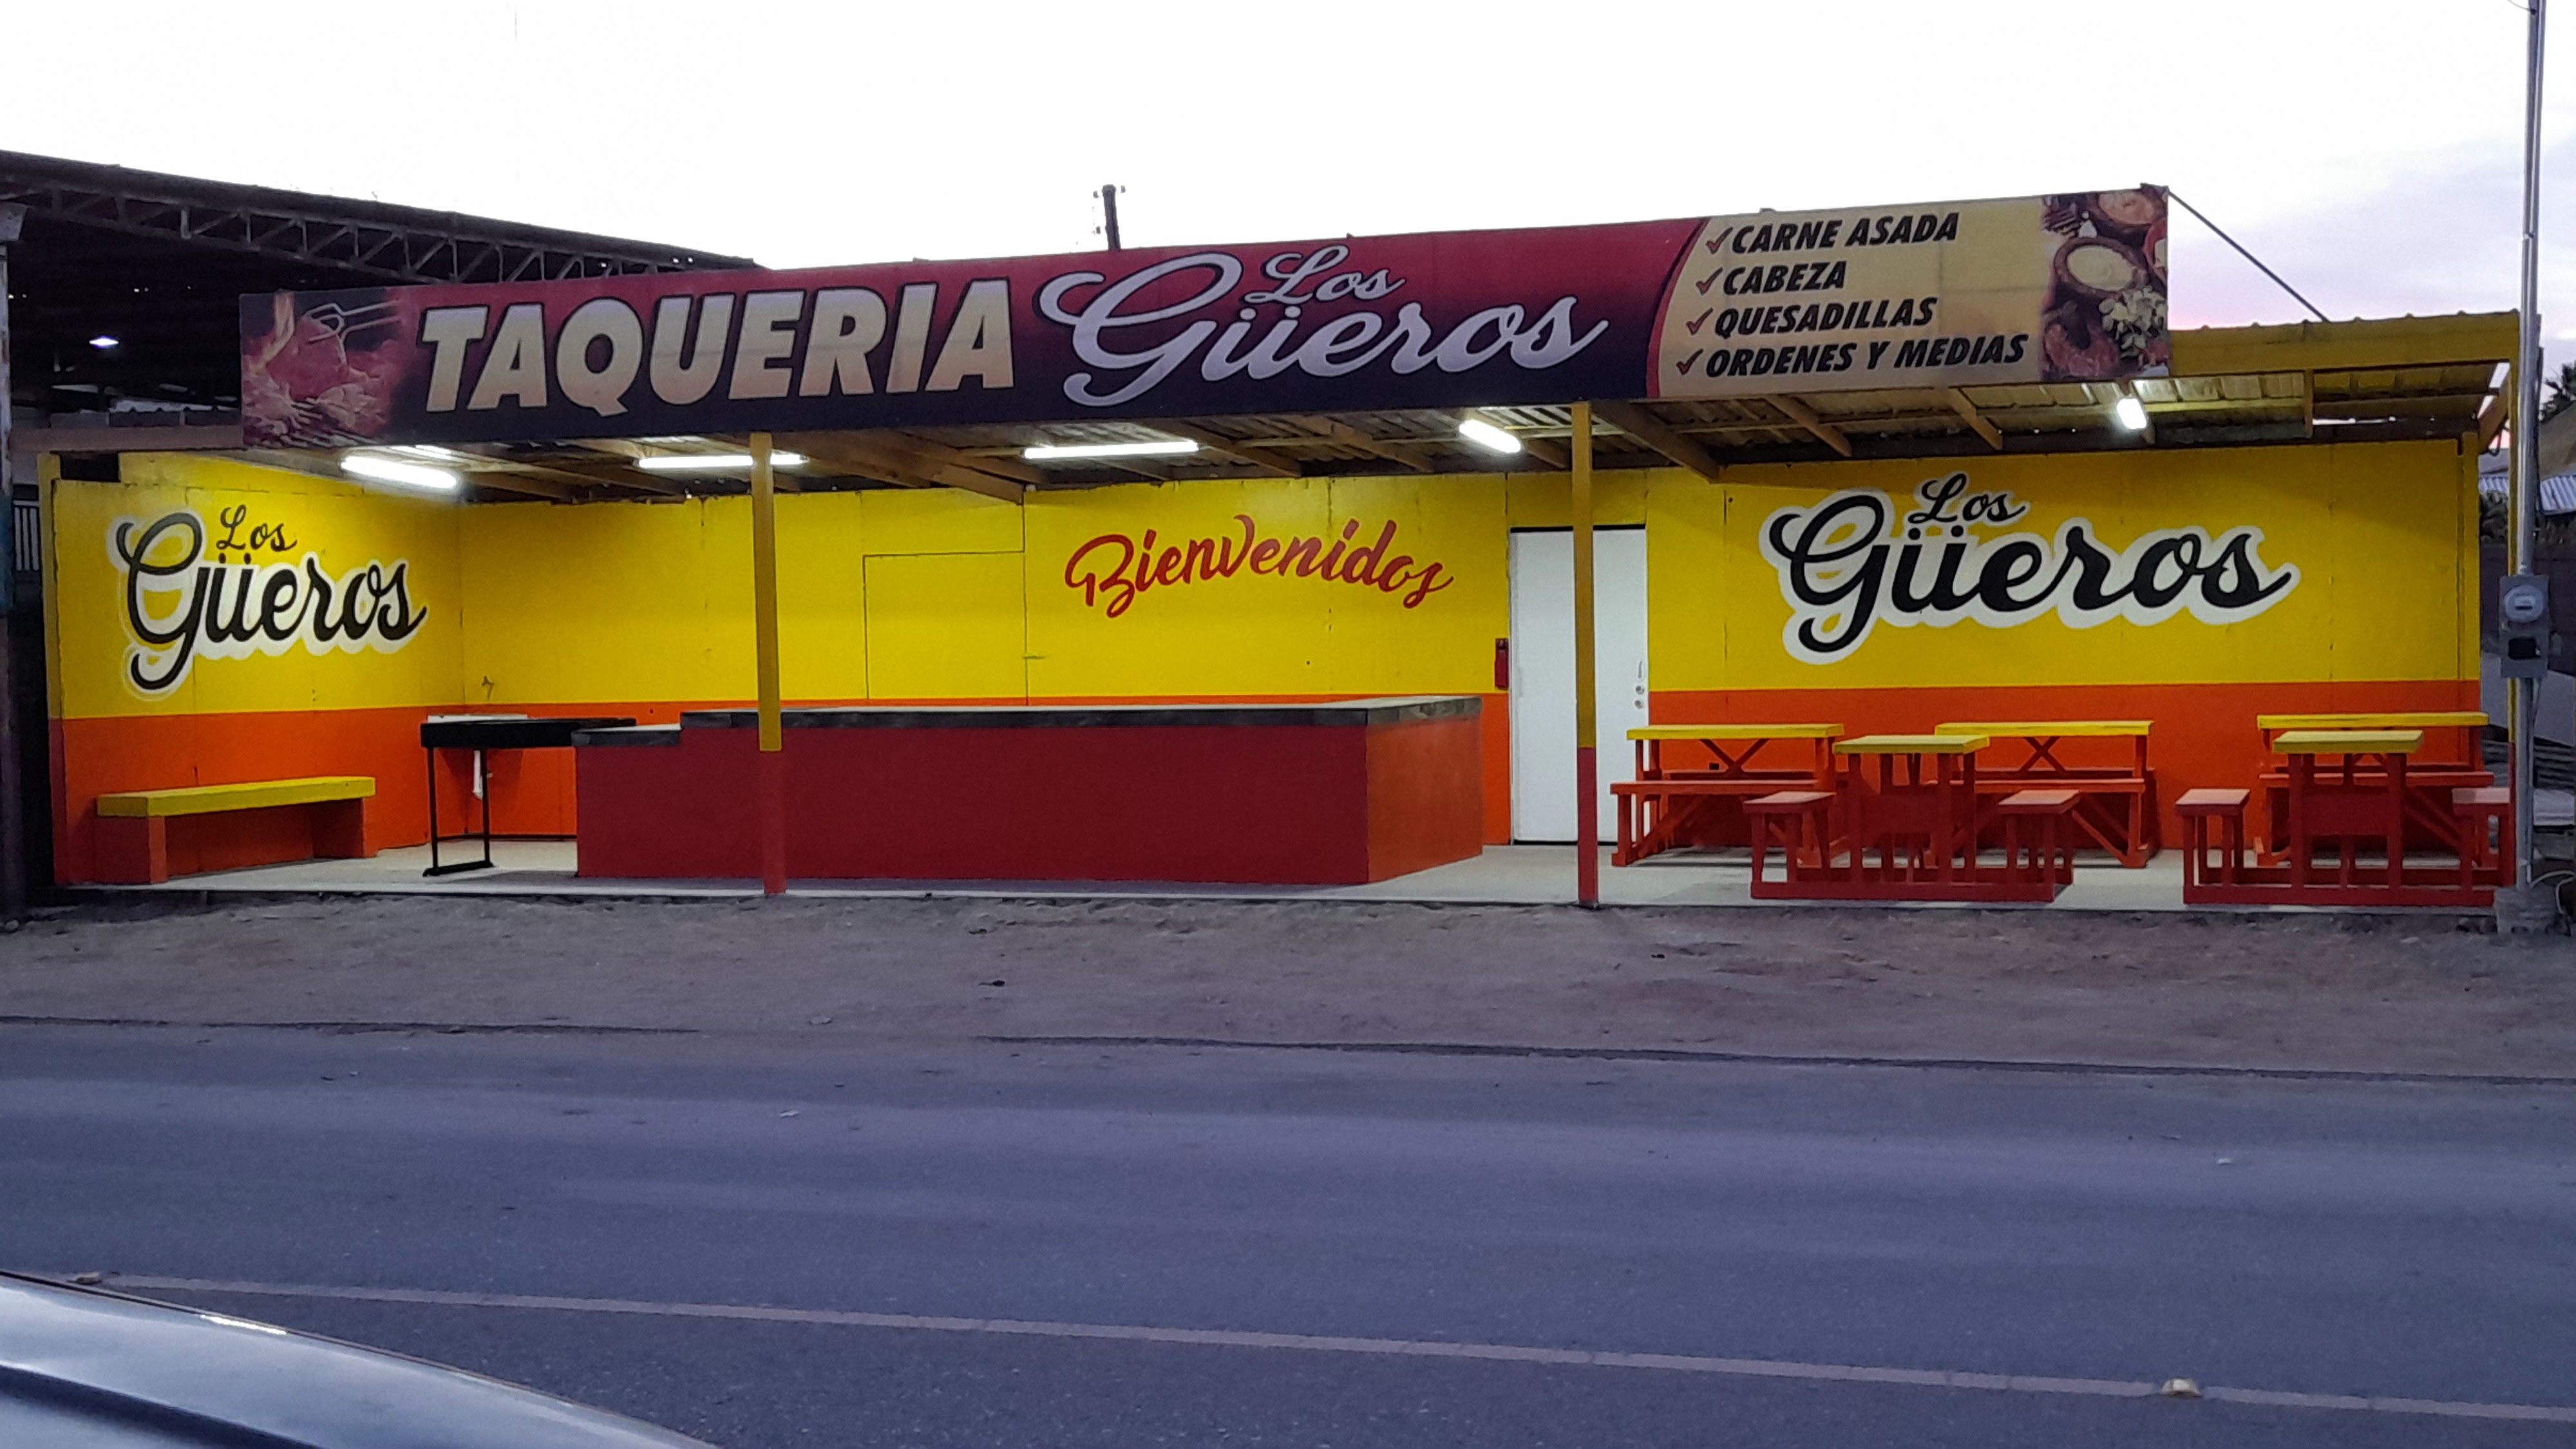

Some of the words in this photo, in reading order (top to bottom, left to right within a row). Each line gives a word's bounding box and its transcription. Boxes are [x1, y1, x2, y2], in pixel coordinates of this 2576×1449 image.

[1732, 220, 1842, 254] CARNE
[1846, 212, 1960, 247] ASADA
[1244, 244, 1405, 305] Los
[1723, 261, 1847, 296] CABEZA
[1039, 252, 1608, 408] Güeros
[1714, 298, 1937, 339] QUESADILLAS
[422, 278, 1015, 417] TAQUERIA
[1705, 341, 1857, 378] ORDENES
[1867, 339, 1890, 370] Y
[1894, 334, 2028, 368] MEDIAS
[1908, 473, 2025, 523] Los
[216, 504, 298, 552] Los
[1065, 514, 1454, 618] Bienvenidos
[1768, 494, 2293, 653] Güeros
[116, 512, 427, 690] Güeros
